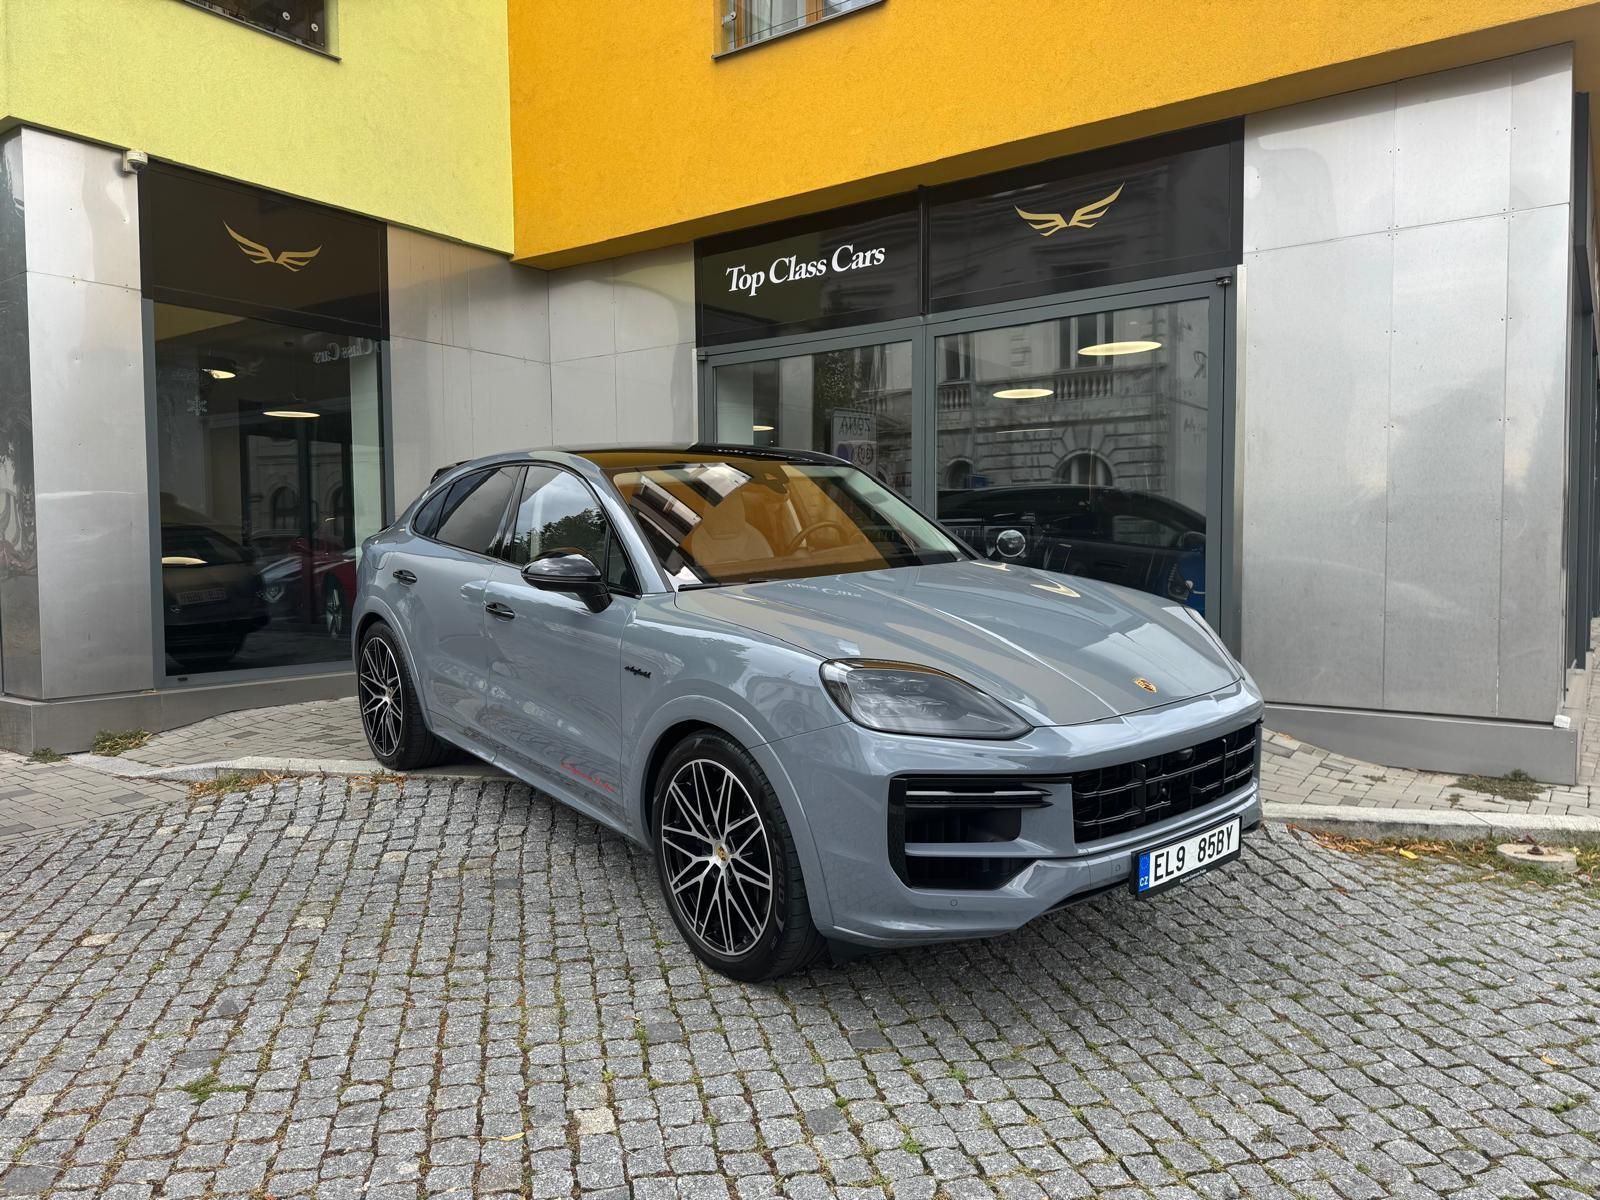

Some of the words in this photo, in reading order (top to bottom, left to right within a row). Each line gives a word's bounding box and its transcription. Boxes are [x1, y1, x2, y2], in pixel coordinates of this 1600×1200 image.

[725, 264, 766, 296] Top
[769, 255, 827, 284] Class
[831, 244, 886, 272] Cars
[1154, 845, 1186, 882] EL9
[1197, 824, 1233, 863] 85BY
[1139, 876, 1149, 887] CZ
